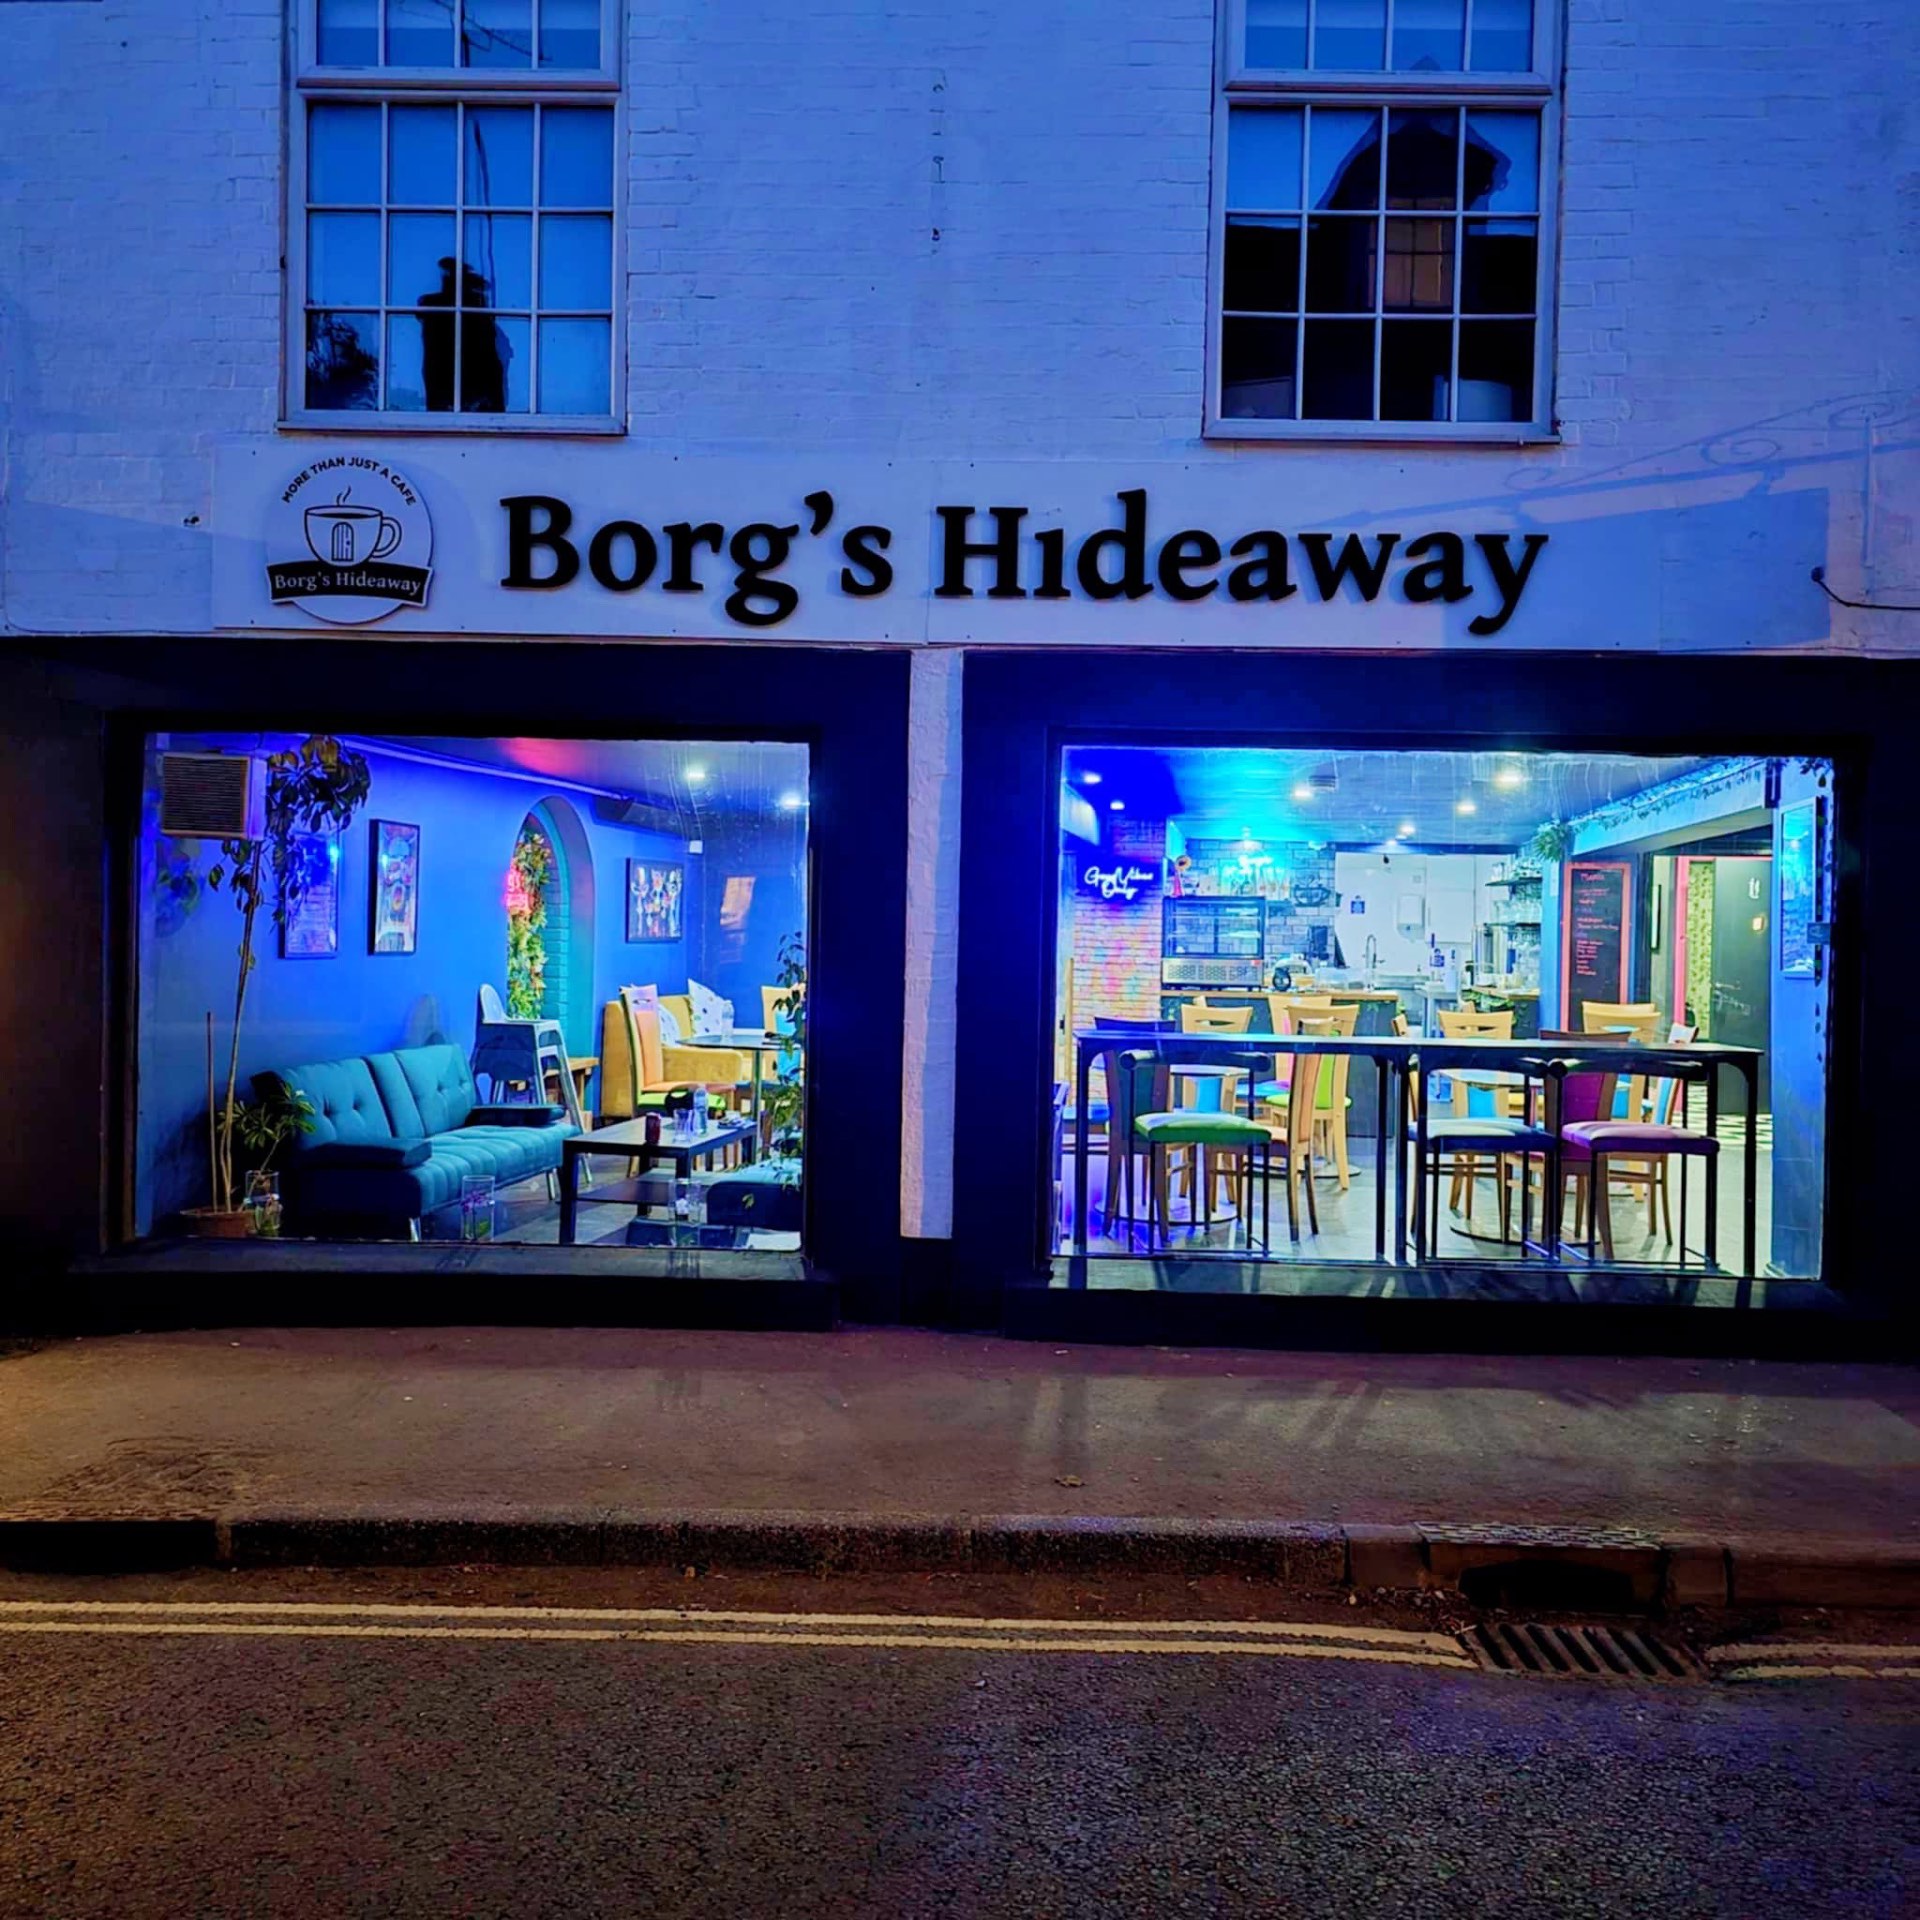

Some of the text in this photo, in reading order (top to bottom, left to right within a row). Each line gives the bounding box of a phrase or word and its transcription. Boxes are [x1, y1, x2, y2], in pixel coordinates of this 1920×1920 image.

[282, 457, 416, 505] MORE THAN JUST A CAFE
[275, 571, 421, 596] Borg's Hideaway
[500, 490, 1549, 635] Borg's Hideaway
